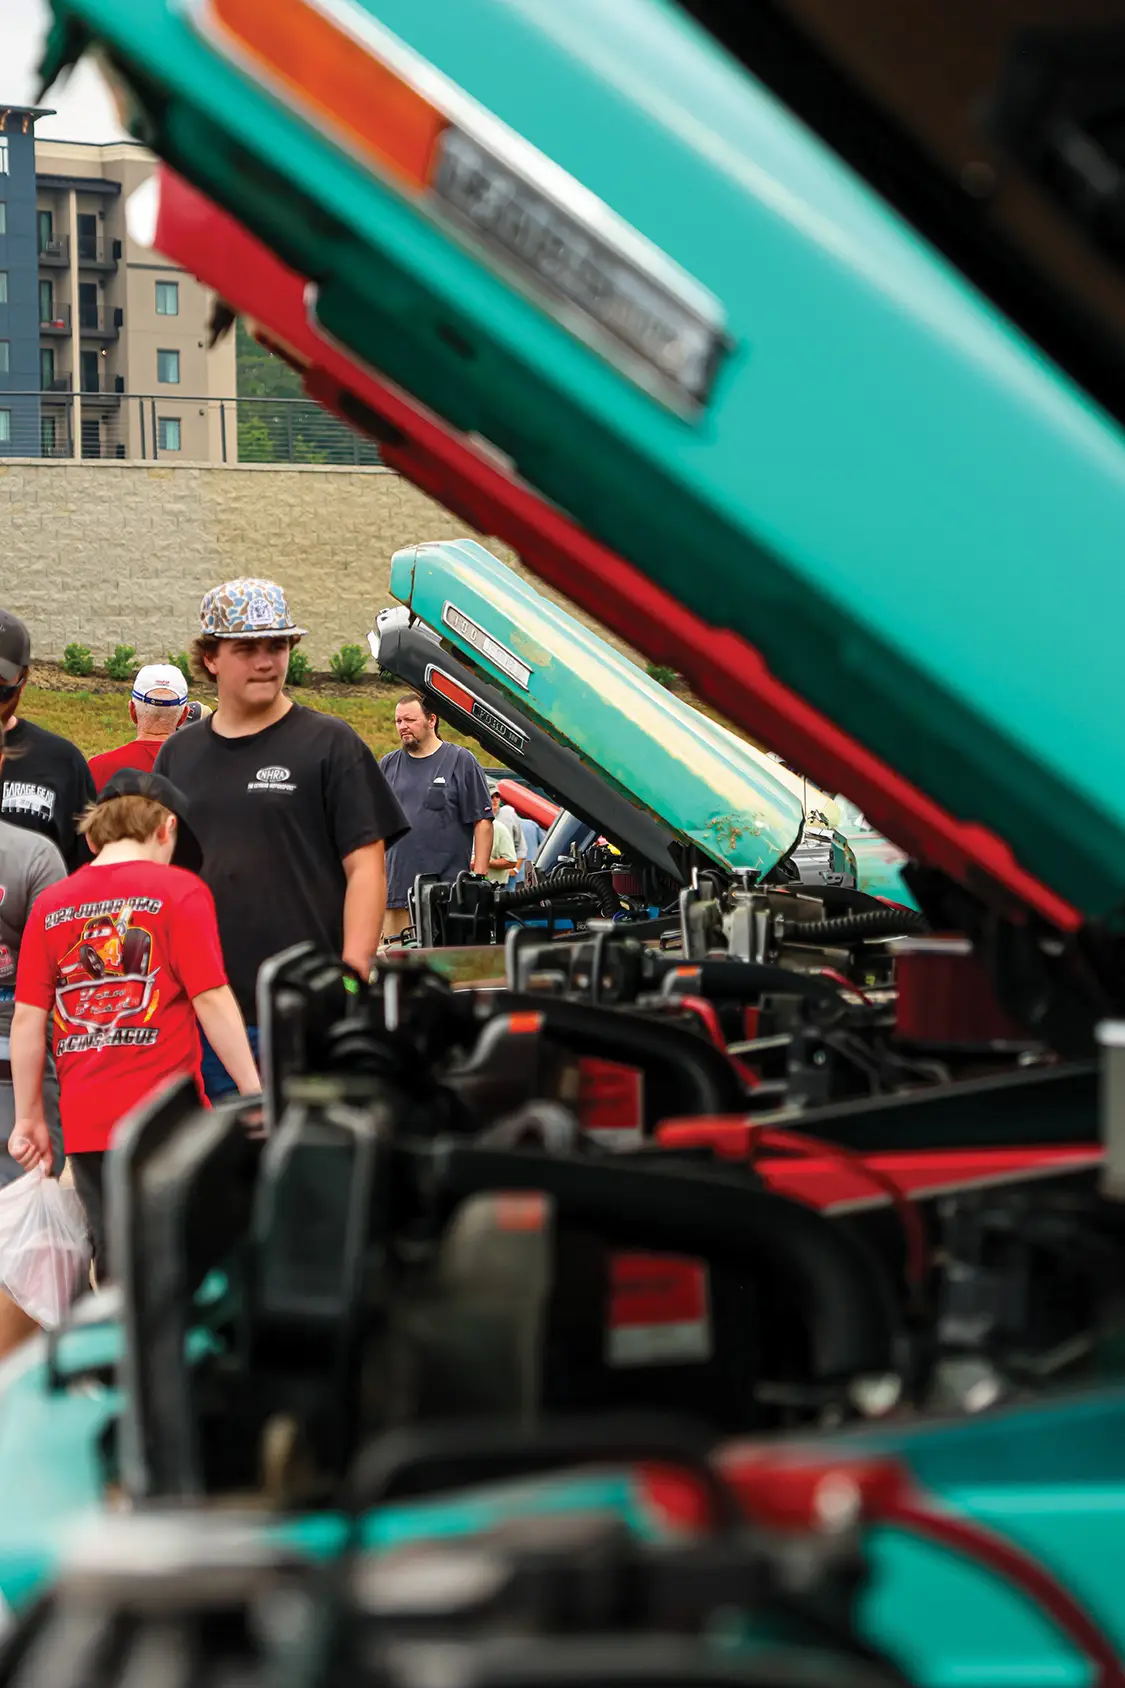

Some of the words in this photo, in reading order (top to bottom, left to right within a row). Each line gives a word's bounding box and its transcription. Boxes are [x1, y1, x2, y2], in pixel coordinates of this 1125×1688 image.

[453, 615, 478, 641] 100
[260, 769, 285, 780] NHRA
[3, 781, 36, 799] GARAGE
[36, 785, 55, 807] GEAR
[45, 906, 76, 930] 2024
